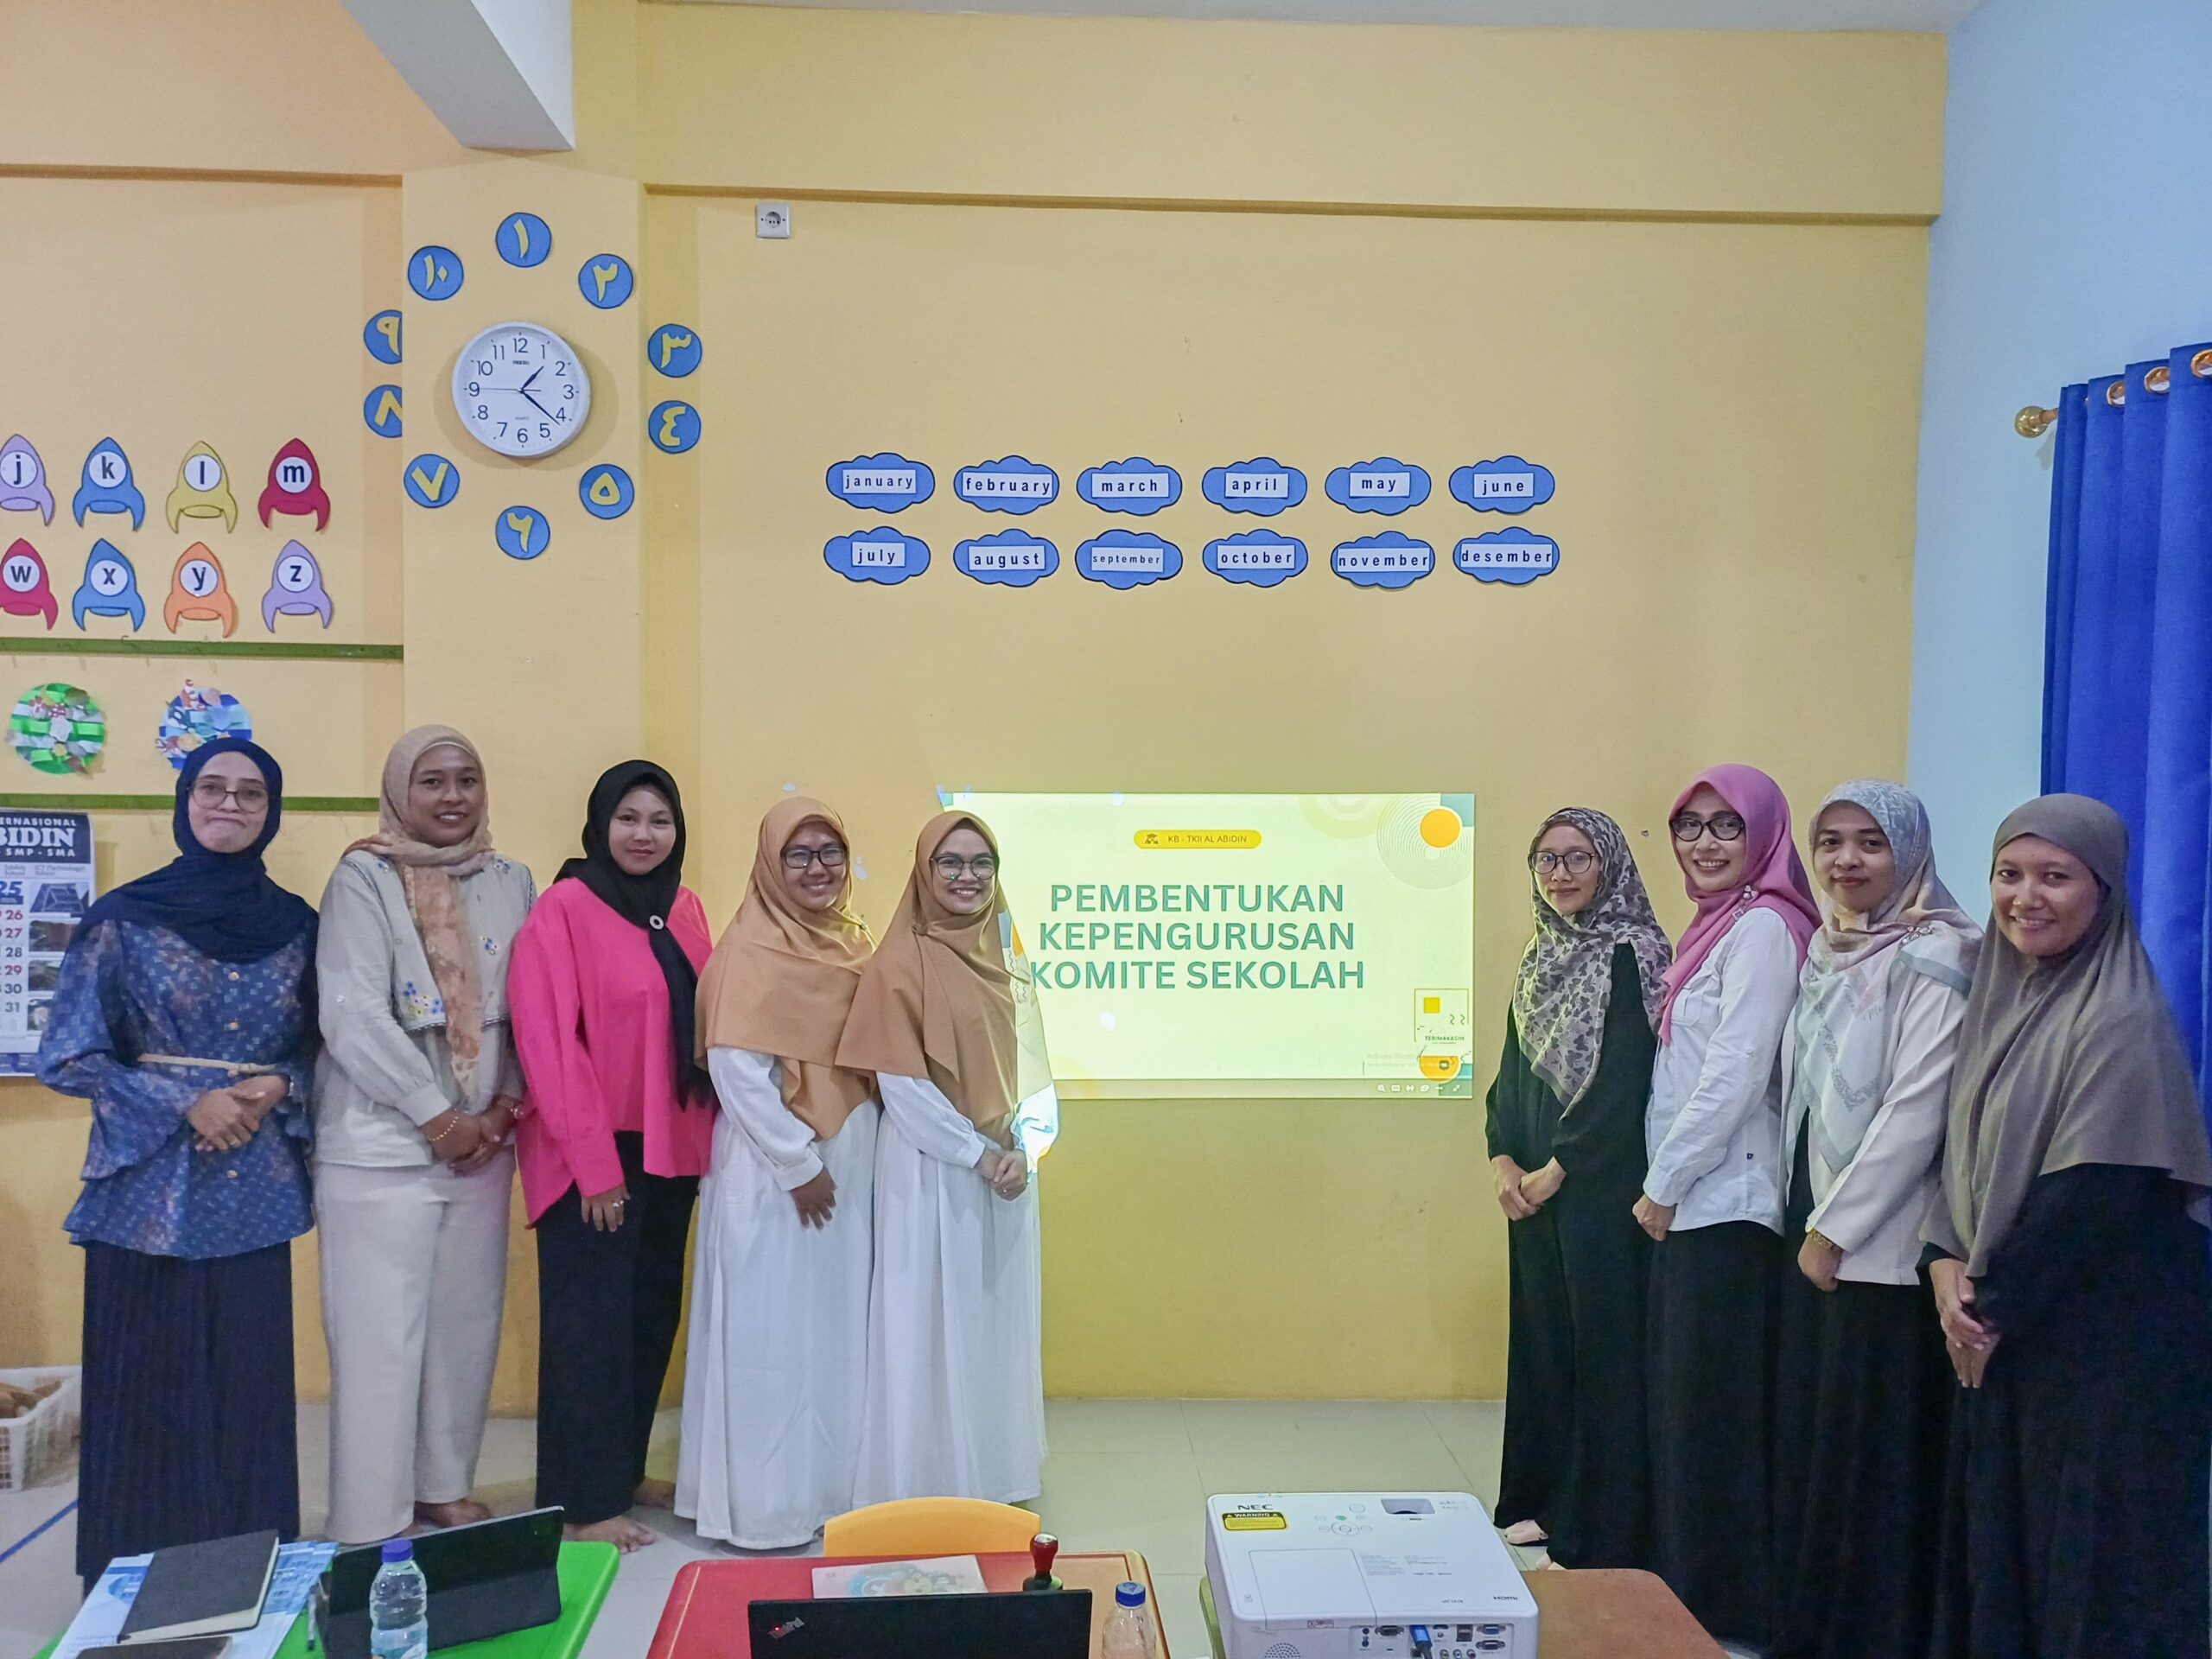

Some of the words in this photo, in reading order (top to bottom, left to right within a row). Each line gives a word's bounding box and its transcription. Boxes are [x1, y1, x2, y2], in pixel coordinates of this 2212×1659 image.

[513, 219, 530, 258] ١
[424, 255, 448, 292] ١٠
[593, 263, 619, 302] ٢
[376, 316, 401, 357] ٩
[493, 345, 505, 360] 11
[512, 338, 529, 353] 12
[541, 344, 545, 359] 1
[661, 333, 692, 369] ٣
[477, 360, 493, 376] 10
[555, 360, 566, 376] 2
[468, 382, 480, 397] 9
[563, 385, 575, 400] 3
[477, 404, 489, 421] 8
[555, 407, 567, 422] 4
[497, 422, 508, 437] 7
[539, 423, 550, 438] 5
[659, 406, 687, 447] ٤
[517, 428, 528, 443] 6
[13, 454, 22, 486] j
[101, 456, 116, 480] k
[283, 464, 305, 483] m
[410, 462, 449, 502] ٧
[588, 472, 621, 505] ٥
[845, 474, 913, 490] january
[965, 478, 1051, 495] february
[1101, 480, 1158, 493] march
[1231, 478, 1277, 493] april
[1361, 478, 1396, 493] may
[1482, 480, 1524, 495] june
[506, 512, 533, 554] ٦
[857, 549, 896, 564] july
[974, 552, 1040, 569] august
[1092, 554, 1160, 566] september
[1220, 551, 1292, 564] october
[1338, 554, 1429, 567] november
[1461, 550, 1552, 563] desember
[10, 566, 32, 583] w
[103, 568, 116, 586] x
[192, 567, 207, 591] y
[289, 565, 302, 582] z
[6, 848, 34, 856] SMP
[48, 849, 75, 857] SMA
[1051, 884, 1343, 912] PEMBENTUKAN
[5, 910, 23, 920] 26
[4, 928, 22, 938] 27
[1039, 922, 1354, 950] KEPENGURUSAN
[5, 947, 22, 957] 28
[5, 965, 22, 976] 29
[1031, 961, 1176, 988] KOMITE
[1186, 960, 1363, 989] SEKOLAH
[4, 983, 22, 994] 30
[5, 1002, 20, 1013] 31
